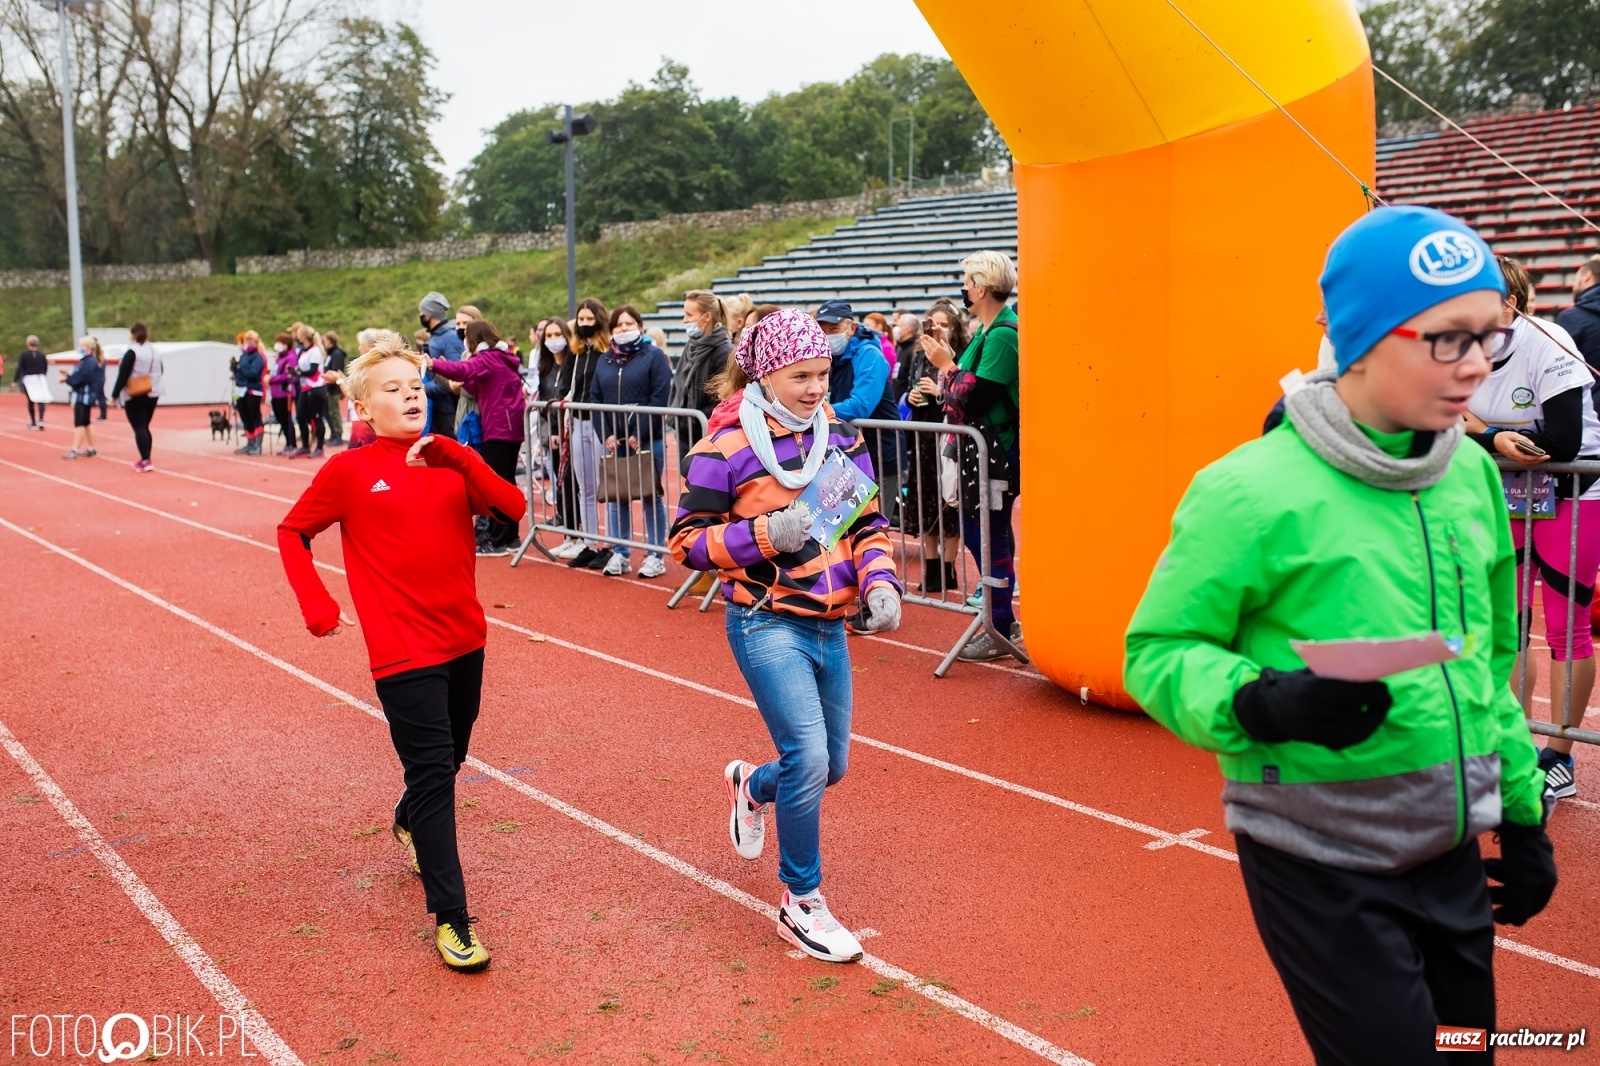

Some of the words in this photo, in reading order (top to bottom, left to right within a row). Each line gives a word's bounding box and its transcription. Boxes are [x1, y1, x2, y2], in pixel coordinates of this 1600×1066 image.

[1420, 235, 1477, 270] LKS
[1442, 250, 1461, 268] 07
[811, 506, 823, 520] IEG
[822, 493, 835, 507] DLA
[847, 483, 870, 509] 079
